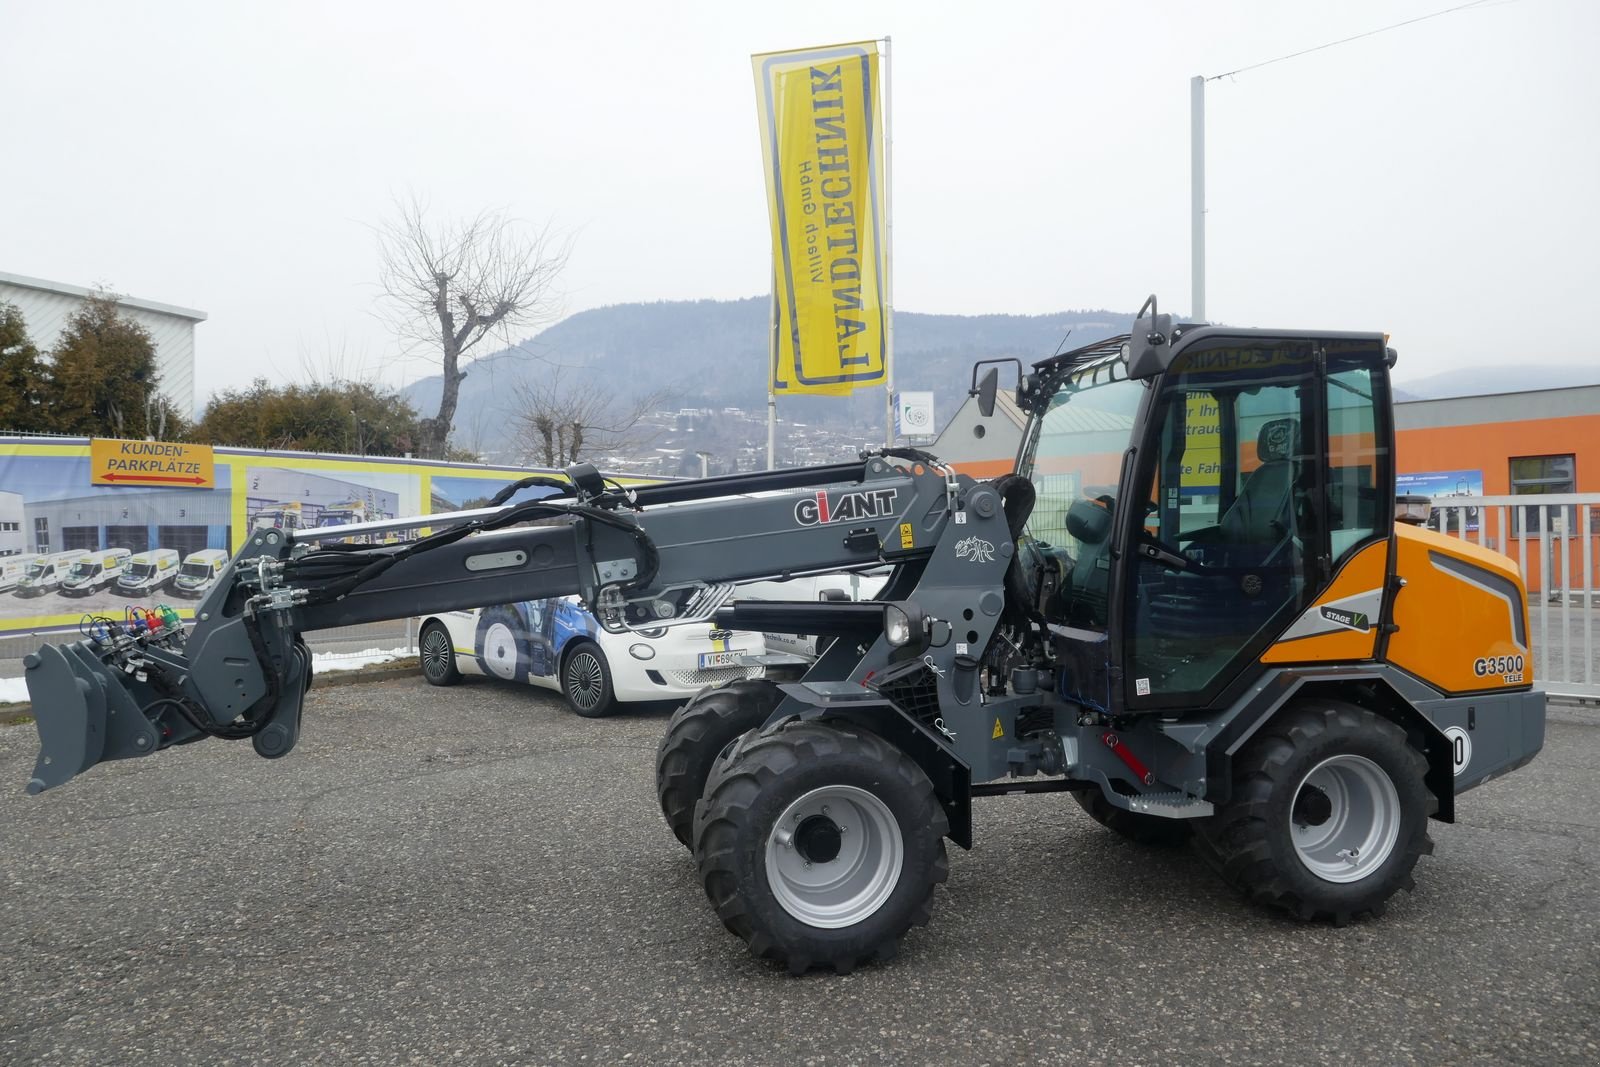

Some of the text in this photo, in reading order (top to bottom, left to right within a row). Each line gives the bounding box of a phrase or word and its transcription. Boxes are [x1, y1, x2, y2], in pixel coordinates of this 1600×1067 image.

[1186, 391, 1209, 399] ank
[1186, 424, 1220, 435] traue
[121, 443, 189, 456] KUNDEN-
[107, 458, 200, 473] PARKPLÄTZE
[1180, 462, 1220, 474] te Fah
[1326, 611, 1351, 624] STAGE
[1474, 655, 1524, 676] G3500
[1504, 674, 1523, 683] TELE
[1455, 736, 1464, 766] 0
